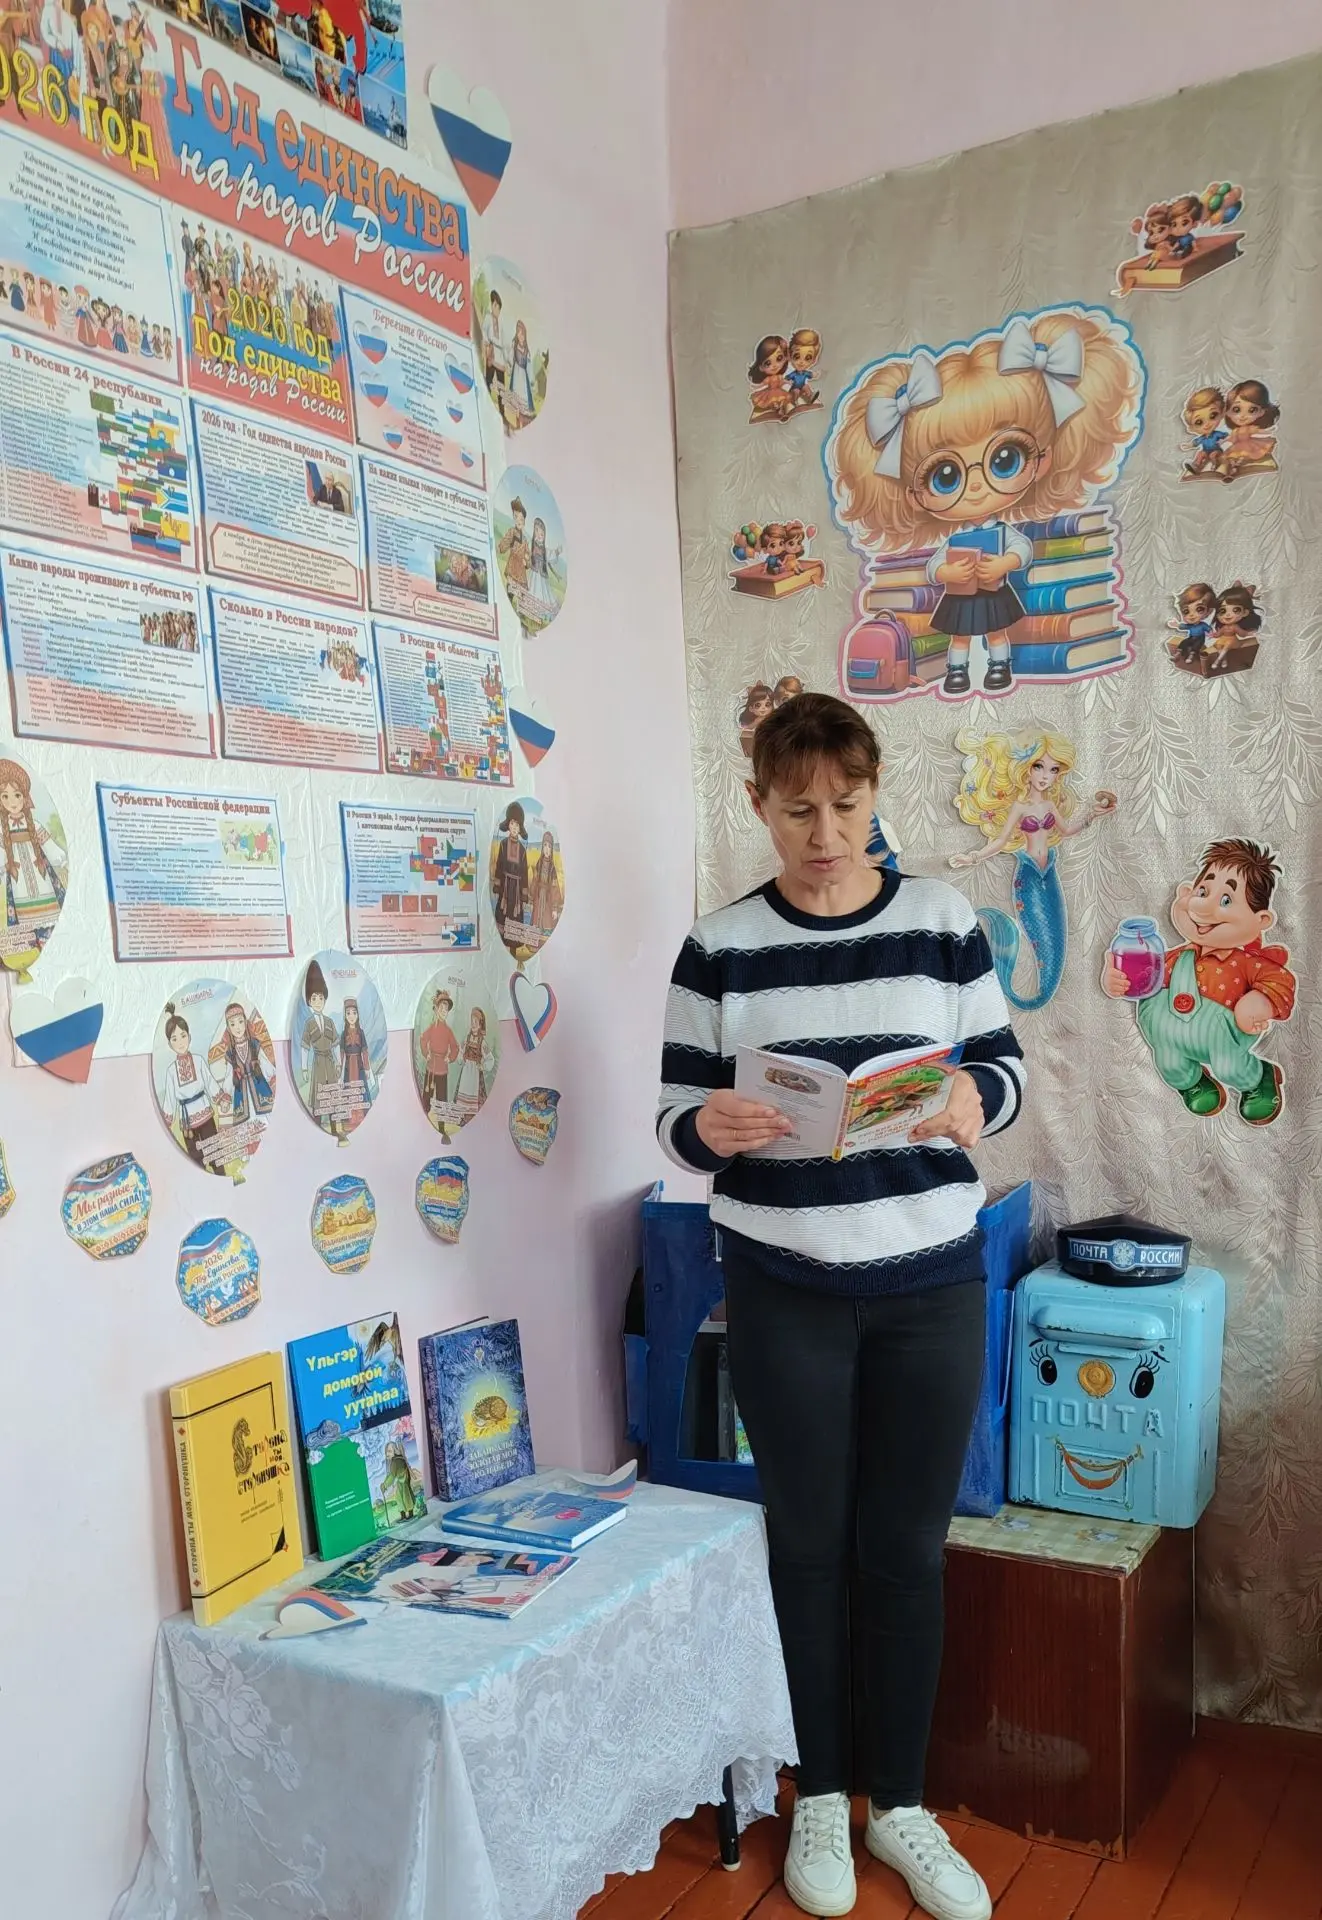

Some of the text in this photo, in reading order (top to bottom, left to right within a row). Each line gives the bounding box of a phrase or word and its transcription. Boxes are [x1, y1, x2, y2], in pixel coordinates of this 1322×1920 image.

[165, 21, 466, 262] Год единства
[179, 142, 466, 313] народов России
[228, 287, 287, 345] 2026
[372, 308, 448, 353] Берегите Россию
[11, 344, 163, 408] В России 24 республики
[192, 315, 238, 367] Год
[243, 345, 343, 404] единства
[200, 357, 347, 424] народов России
[201, 409, 222, 429] 2026
[8, 553, 38, 571] Какие
[41, 564, 76, 580] народы
[78, 571, 130, 590] проживают
[140, 582, 181, 600] субъектах
[182, 589, 194, 603] РФ
[219, 597, 264, 619] Сколько
[275, 609, 311, 628] России
[314, 619, 358, 637] народов?
[408, 635, 436, 650] России
[111, 792, 271, 815] Субъекты Российской федерации
[73, 1199, 97, 1222] Мы
[83, 1215, 99, 1229] ЭТОМ
[100, 1204, 118, 1219] НАША
[119, 1191, 143, 1209] СИЛА!
[204, 1252, 223, 1269] 2026
[1072, 1241, 1181, 1265] ПОЧТА РОССИИ
[323, 1363, 383, 1398] домогой
[1032, 1393, 1164, 1438] ПОЧТА
[179, 1440, 192, 1497] СТОРОНУШКА
[188, 1537, 199, 1574] СТОРОНА
